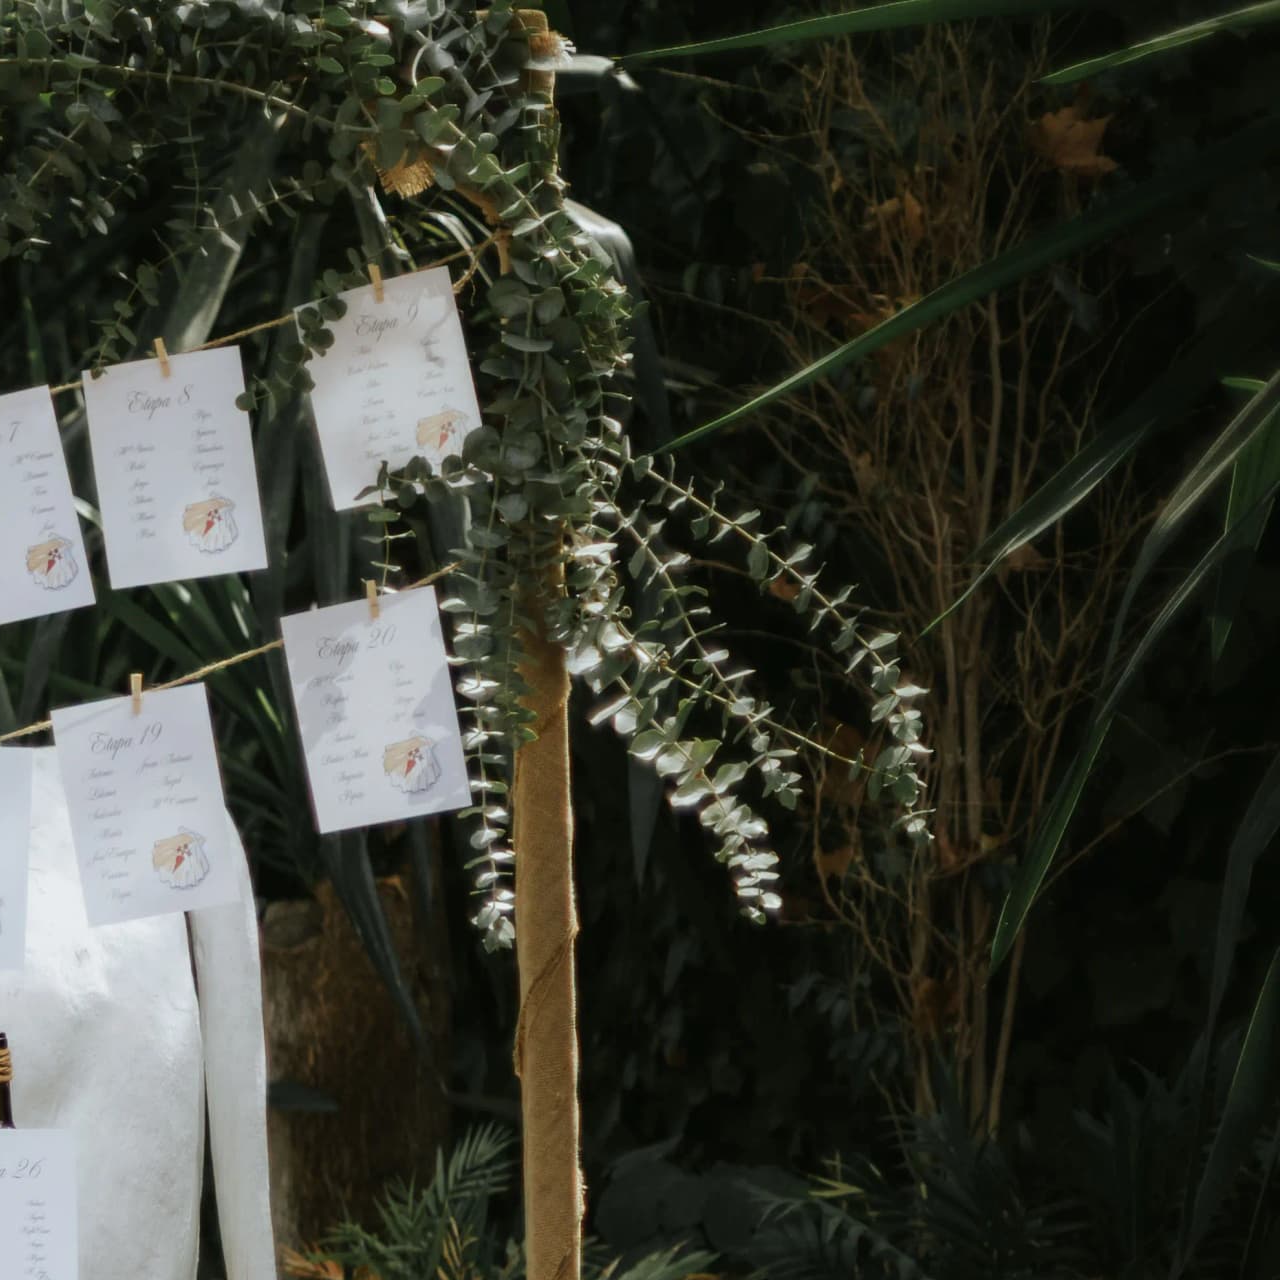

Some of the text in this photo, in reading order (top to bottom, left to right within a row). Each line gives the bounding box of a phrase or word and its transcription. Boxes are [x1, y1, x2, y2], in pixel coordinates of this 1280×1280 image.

[354, 304, 421, 341] Etapa 9
[128, 385, 195, 419] Etapa 8
[8, 422, 21, 443] 7
[317, 624, 396, 667] Etapa 20
[90, 722, 162, 761] Etapa 19
[13, 1158, 46, 1179] 26
